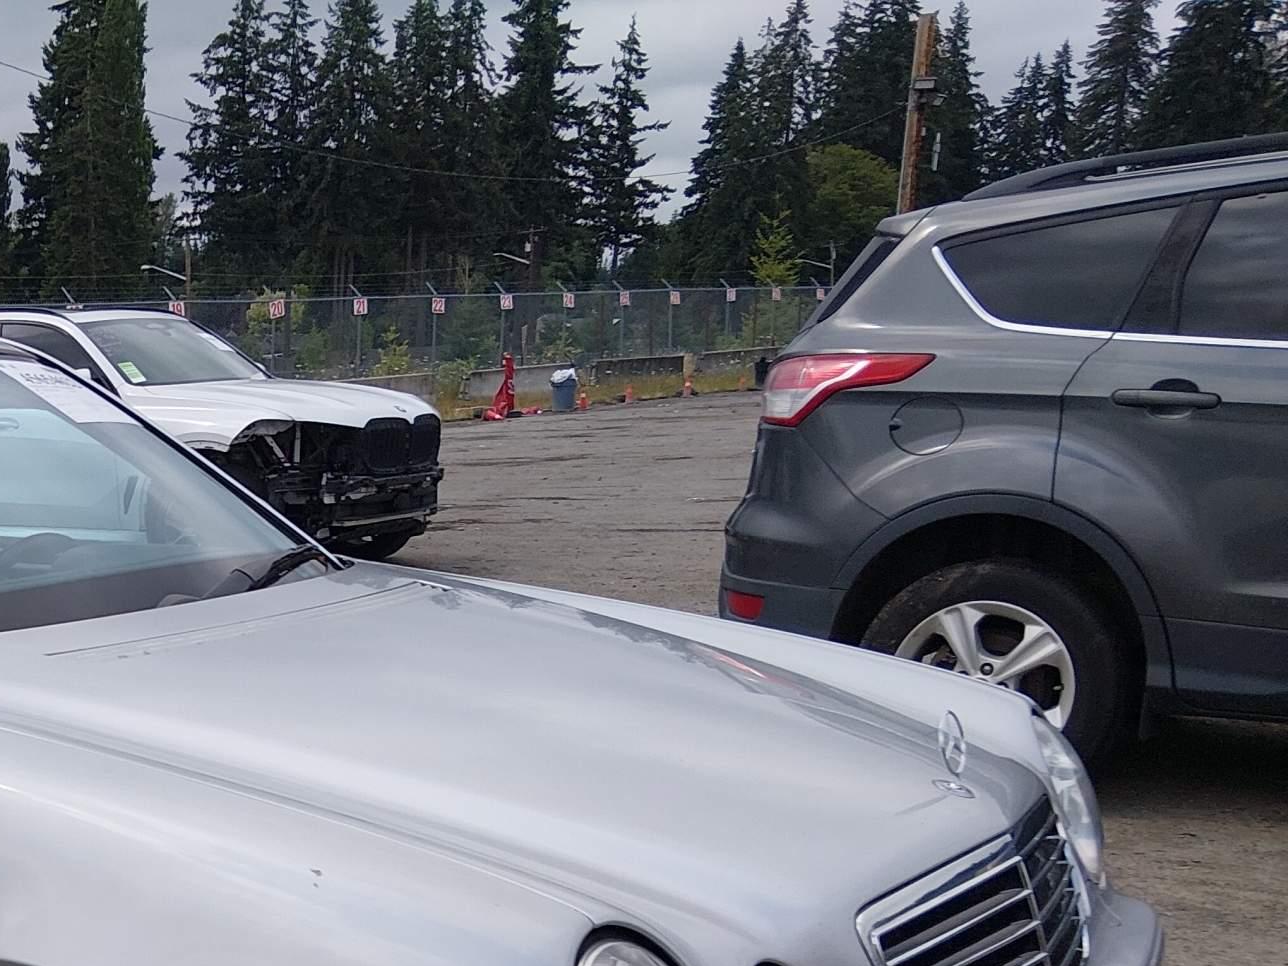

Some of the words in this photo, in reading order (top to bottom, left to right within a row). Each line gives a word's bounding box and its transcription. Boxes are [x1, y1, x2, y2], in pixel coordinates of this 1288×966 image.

[433, 299, 444, 313] 22
[501, 295, 512, 308] 23
[564, 294, 573, 306] 24
[172, 303, 183, 316] 19
[271, 302, 282, 317] 20
[355, 300, 366, 314] 21
